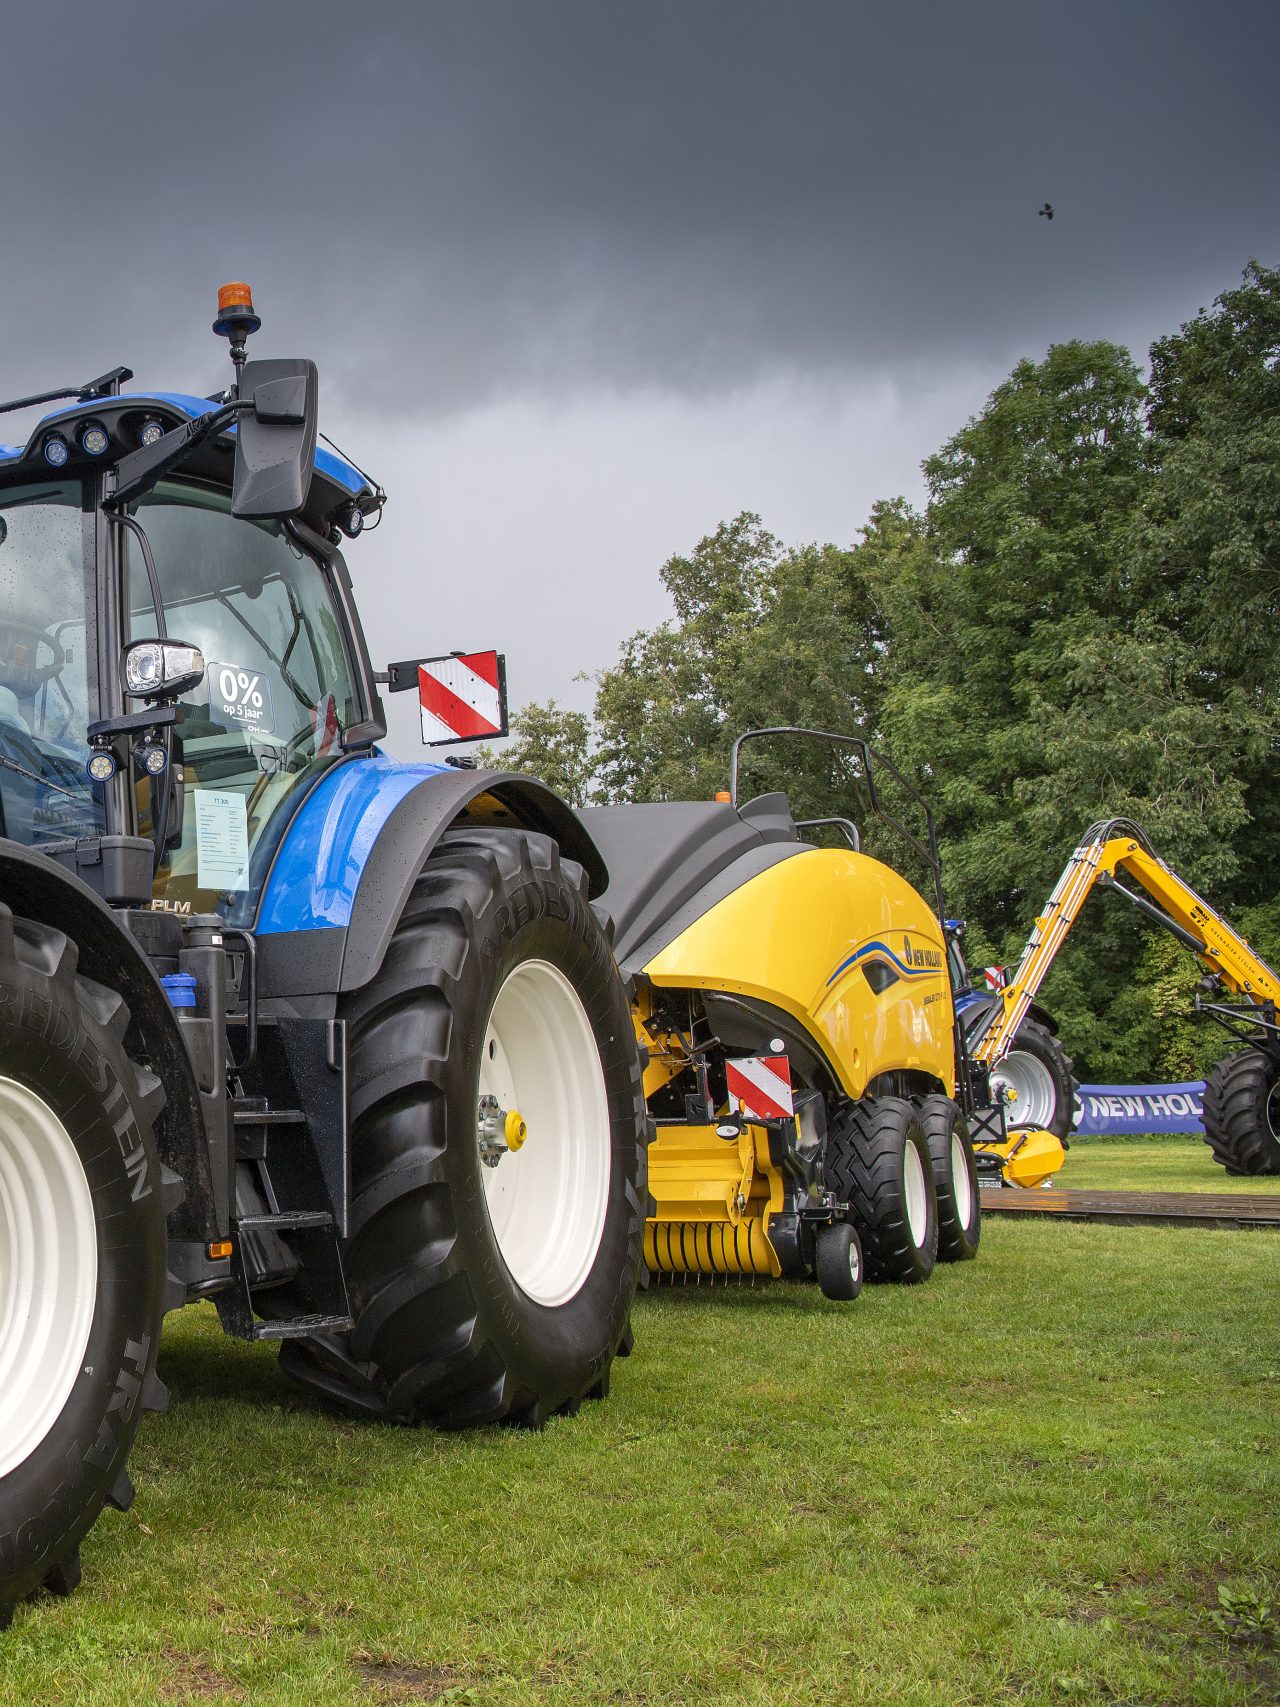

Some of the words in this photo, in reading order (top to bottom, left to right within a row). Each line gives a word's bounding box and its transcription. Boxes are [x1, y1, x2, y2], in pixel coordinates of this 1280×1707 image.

[220, 670, 263, 708] 0%
[223, 705, 235, 715] op
[237, 705, 243, 715] 5
[151, 899, 191, 914] PLM
[1088, 1096, 1145, 1117] NEW
[1146, 1093, 1205, 1115] HOL
